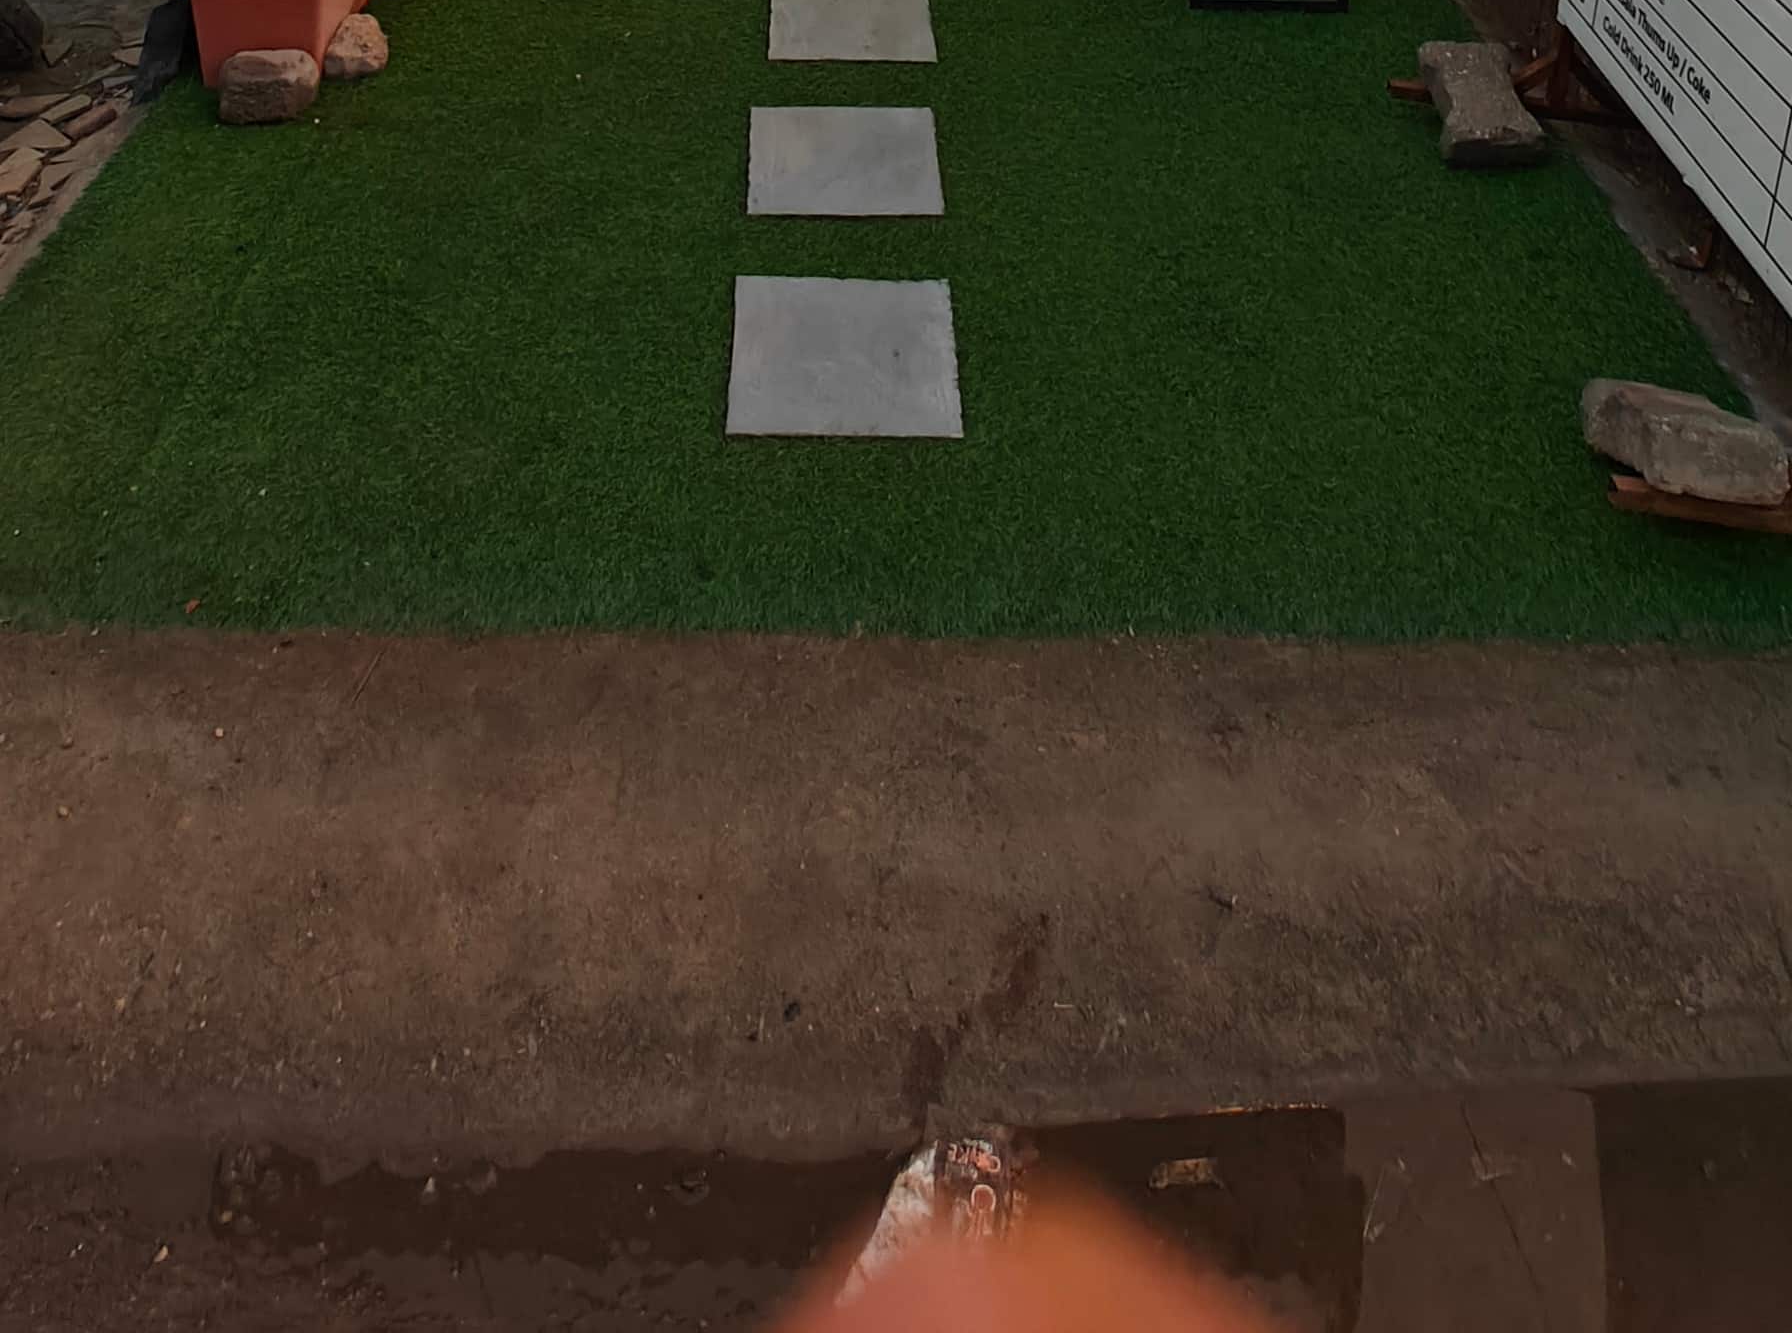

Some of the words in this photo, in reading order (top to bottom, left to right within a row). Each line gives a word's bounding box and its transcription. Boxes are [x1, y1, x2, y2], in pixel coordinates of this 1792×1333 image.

[1603, 16, 1619, 46] Cold
[1620, 39, 1644, 76] Drink
[1643, 64, 1661, 96] 250
[1661, 85, 1675, 116] ML
[1666, 41, 1680, 70] Up
[1687, 66, 1711, 105] Coke
